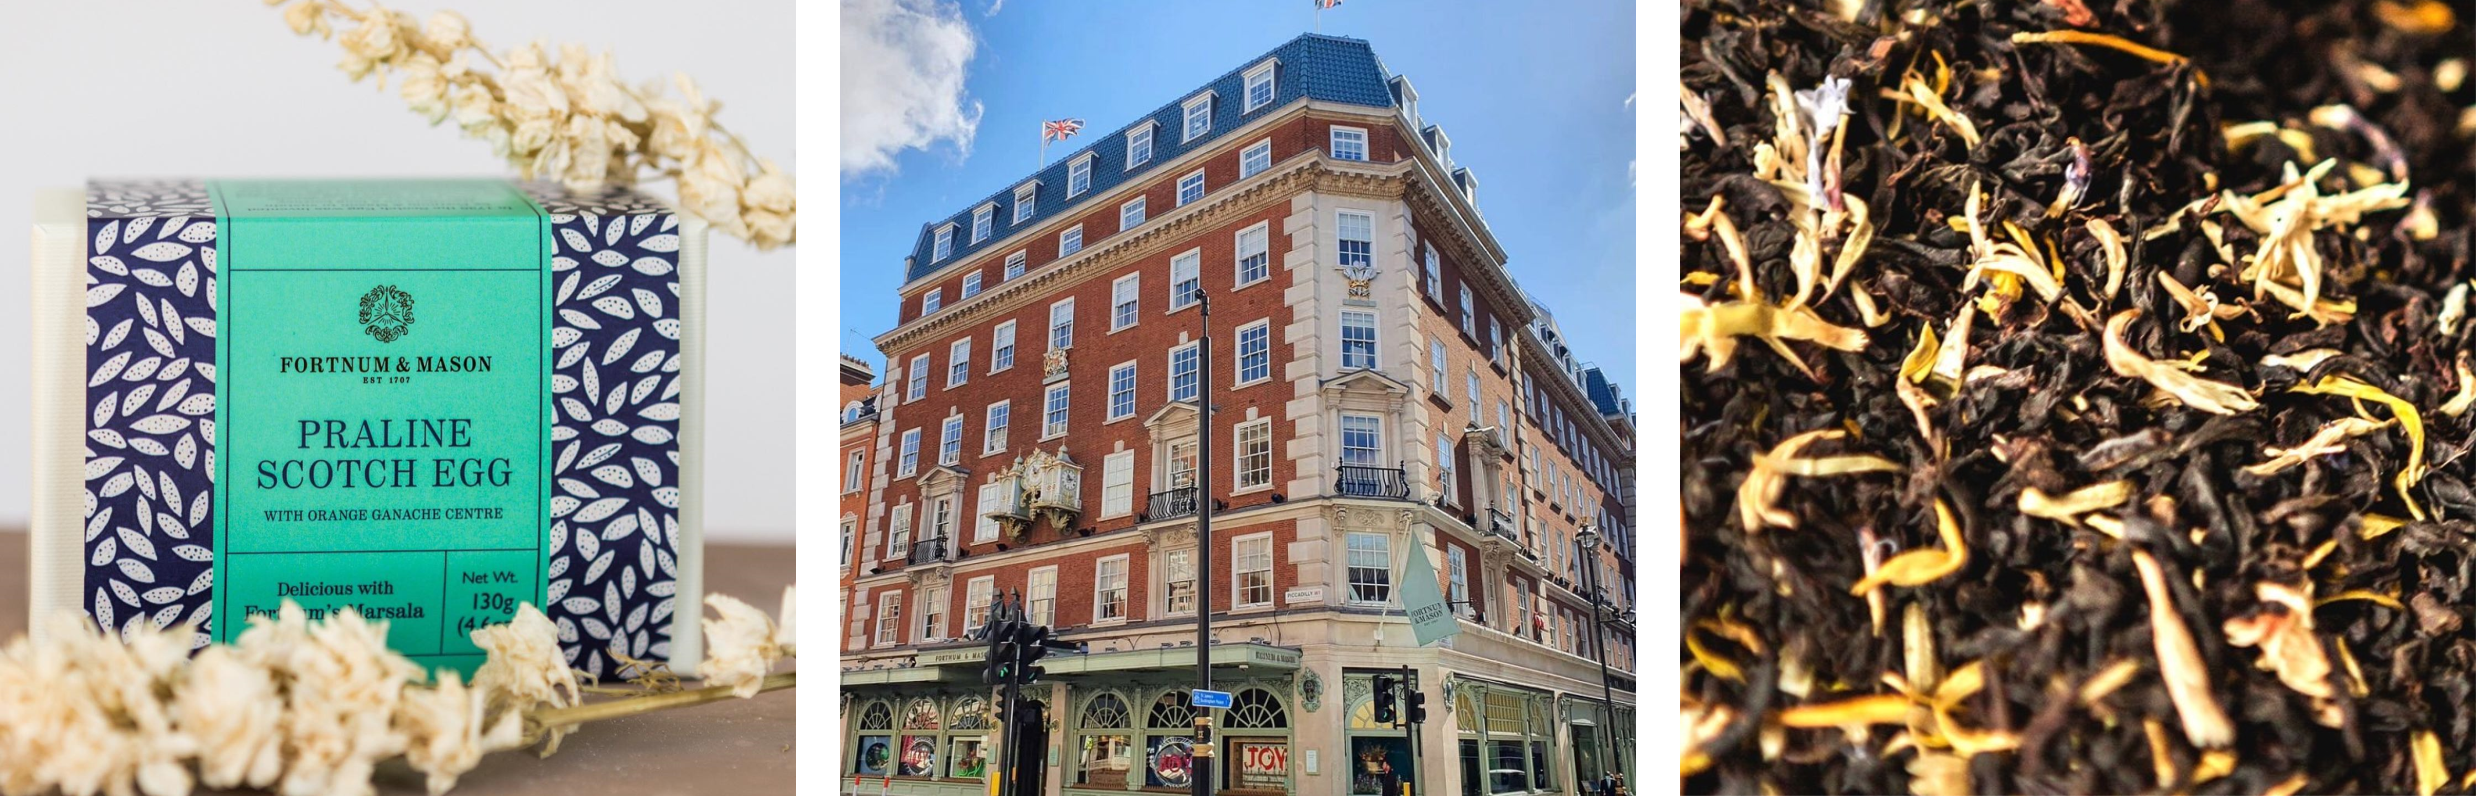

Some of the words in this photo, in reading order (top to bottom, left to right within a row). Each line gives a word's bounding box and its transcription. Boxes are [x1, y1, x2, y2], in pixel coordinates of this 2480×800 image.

[280, 356, 390, 373] FORTNUM
[396, 356, 411, 373] &
[416, 356, 492, 373] MASON
[363, 376, 383, 384] EST
[389, 376, 411, 384] 1707
[298, 418, 472, 449] PRALINE
[257, 459, 417, 489] SCOTCH
[432, 458, 513, 488] EGG
[264, 510, 304, 522] WITH
[307, 509, 368, 522] ORANGE
[372, 508, 441, 521] GANACHE
[445, 507, 504, 520] CENTRE
[462, 571, 489, 584] Net
[493, 571, 519, 583] Wt.
[277, 582, 353, 597] Delicious
[357, 581, 394, 595] with
[473, 592, 515, 615] 130g
[1247, 747, 1288, 772] JOY
